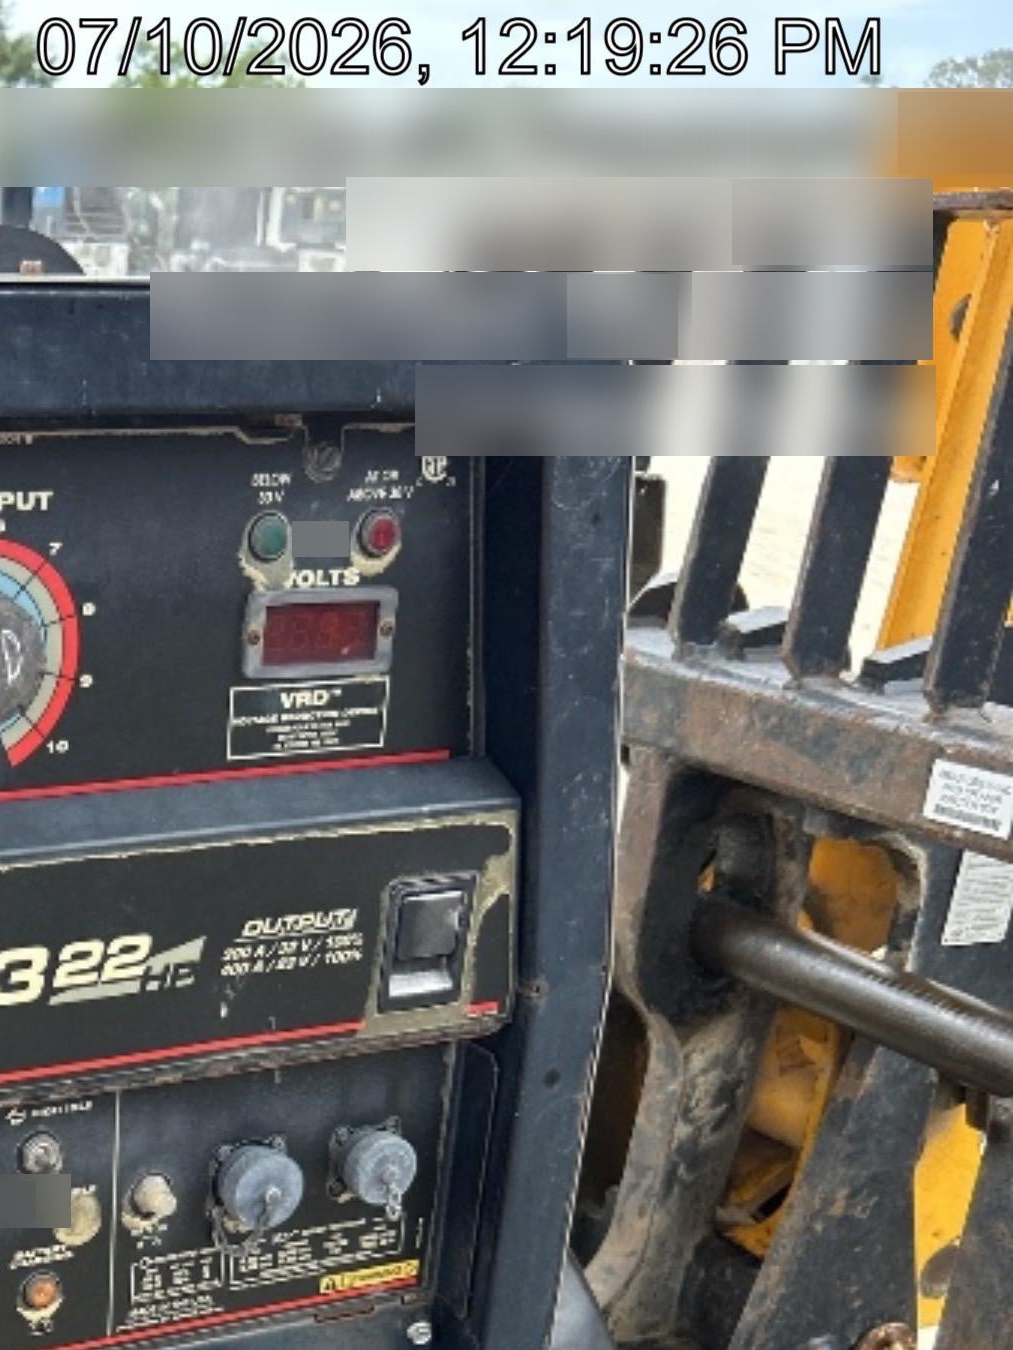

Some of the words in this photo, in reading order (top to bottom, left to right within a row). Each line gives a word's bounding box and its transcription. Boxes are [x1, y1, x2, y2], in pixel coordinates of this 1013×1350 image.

[49, 542, 64, 555] 7
[280, 690, 330, 709] VRD
[46, 740, 69, 754] 10
[242, 909, 354, 937] OUTPUT
